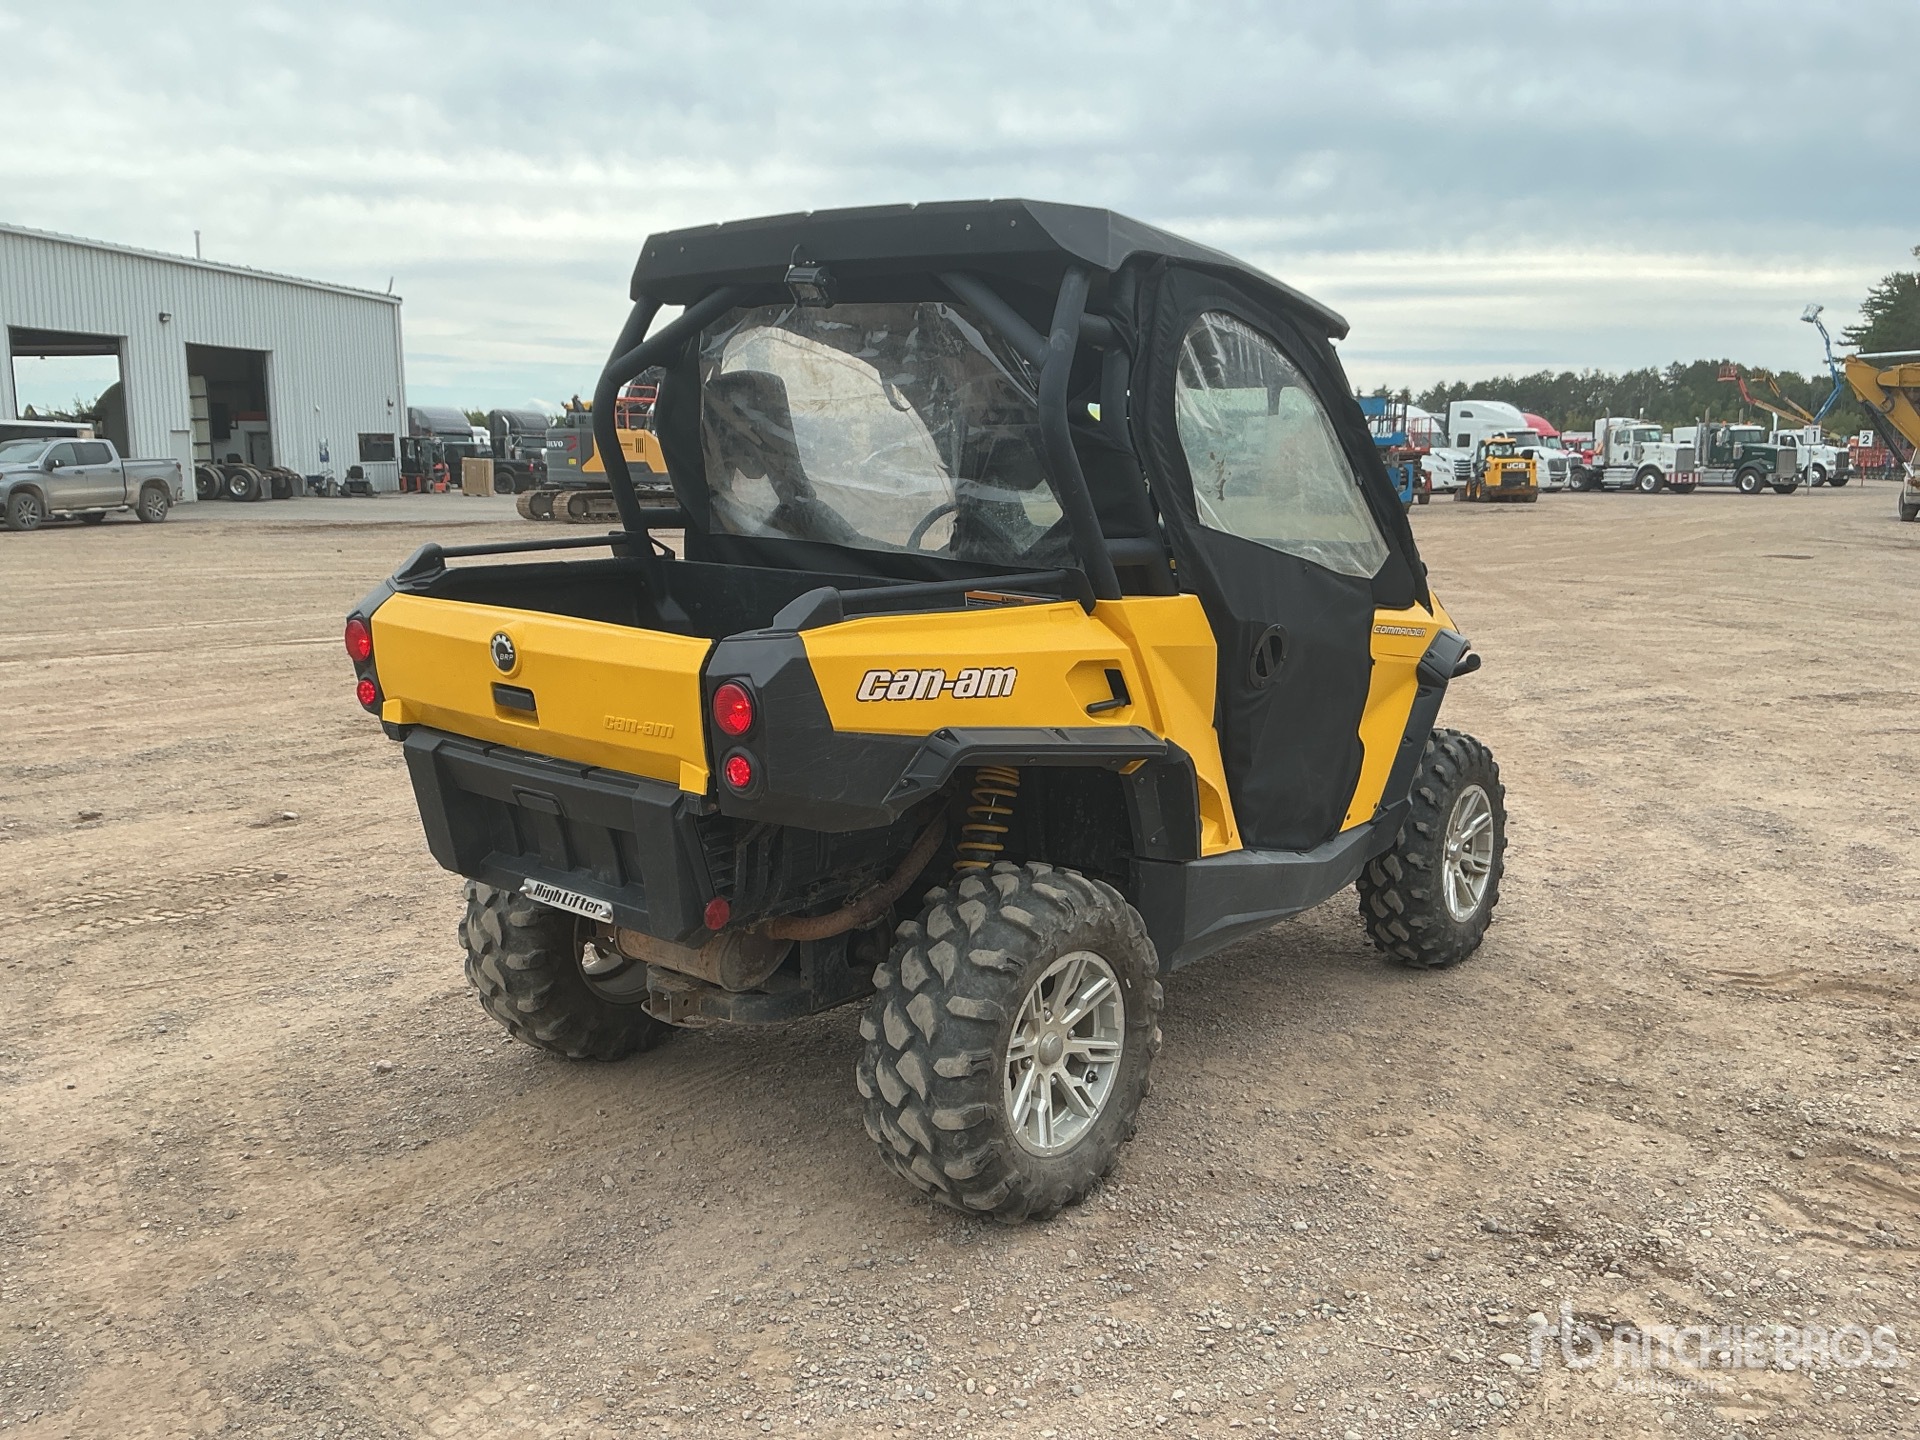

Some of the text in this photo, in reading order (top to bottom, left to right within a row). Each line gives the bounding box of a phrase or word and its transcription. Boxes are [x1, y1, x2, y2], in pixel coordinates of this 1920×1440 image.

[1862, 434, 1870, 445] 2
[499, 653, 514, 661] BRP
[856, 667, 1018, 702] can-am
[603, 714, 674, 738] can-am
